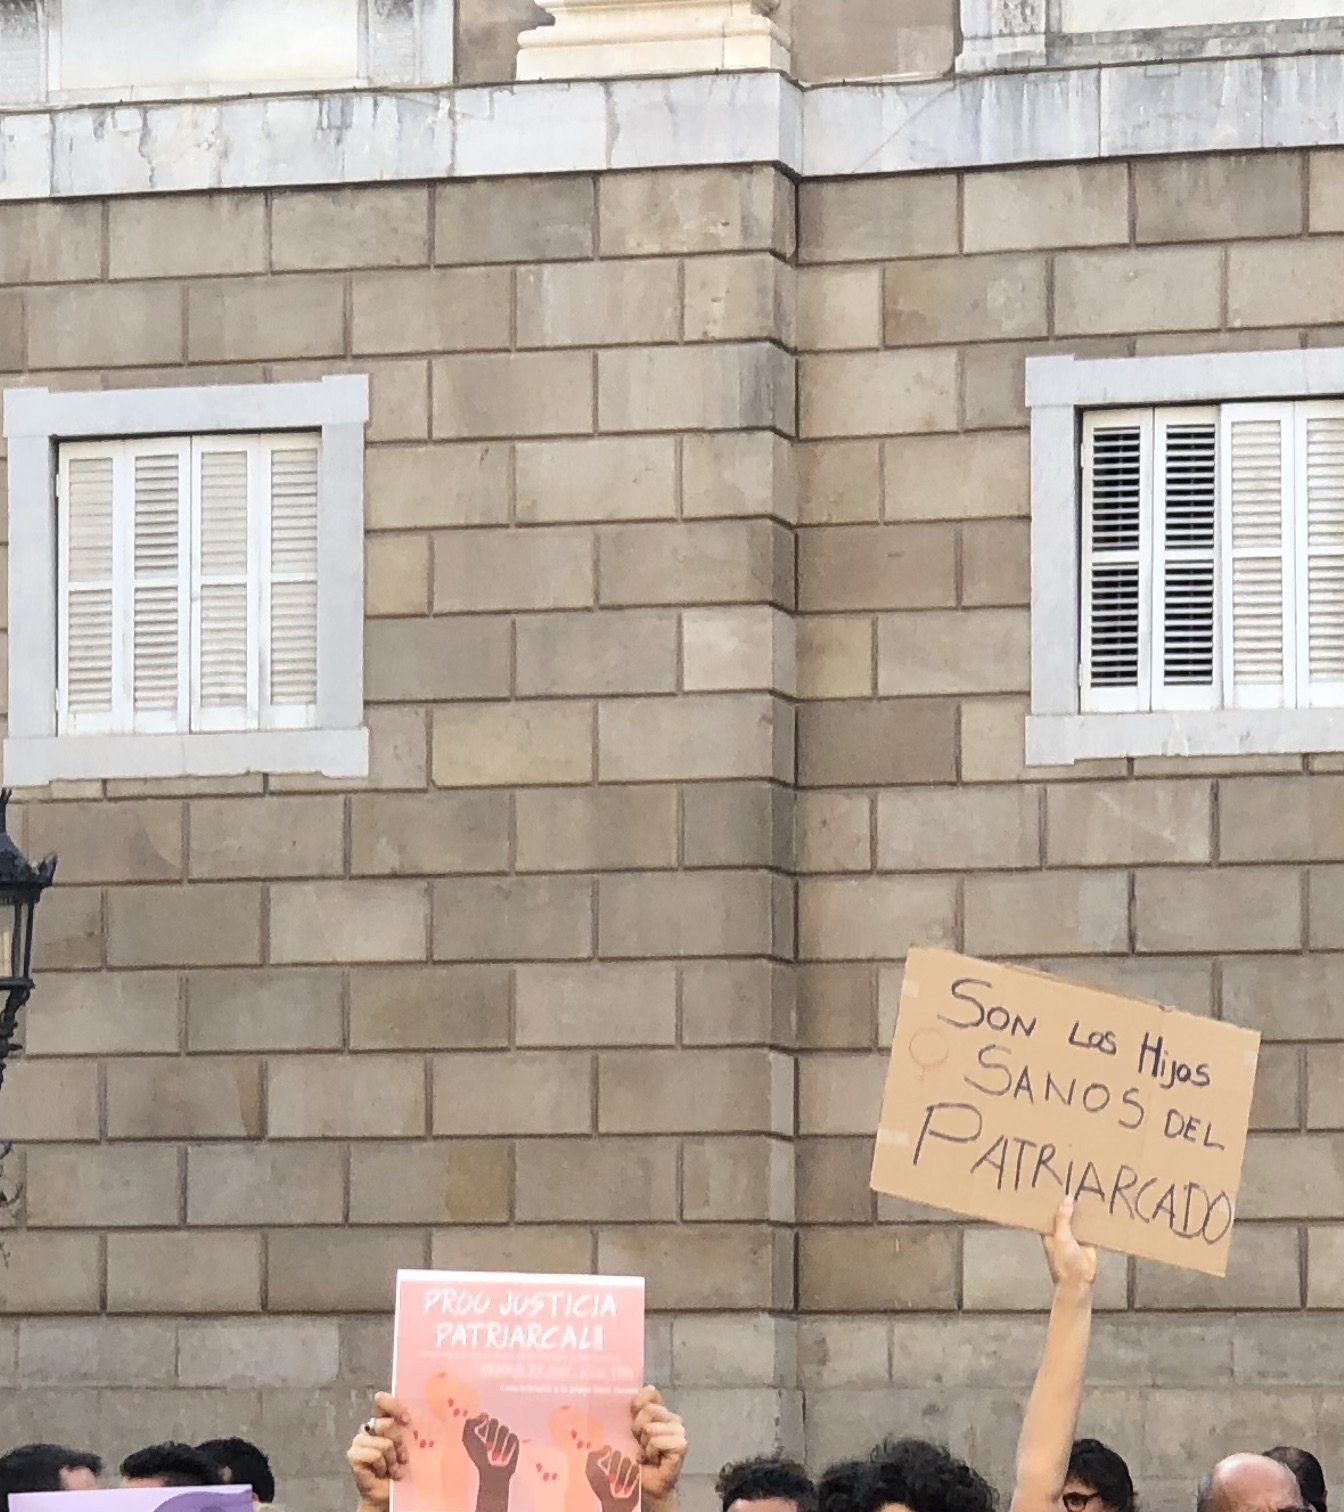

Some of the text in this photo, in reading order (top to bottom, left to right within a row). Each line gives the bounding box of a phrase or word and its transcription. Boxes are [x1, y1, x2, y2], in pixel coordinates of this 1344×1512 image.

[964, 1044, 1226, 1151] SANOS DEL
[423, 1287, 618, 1318] PROU JUSTICIA
